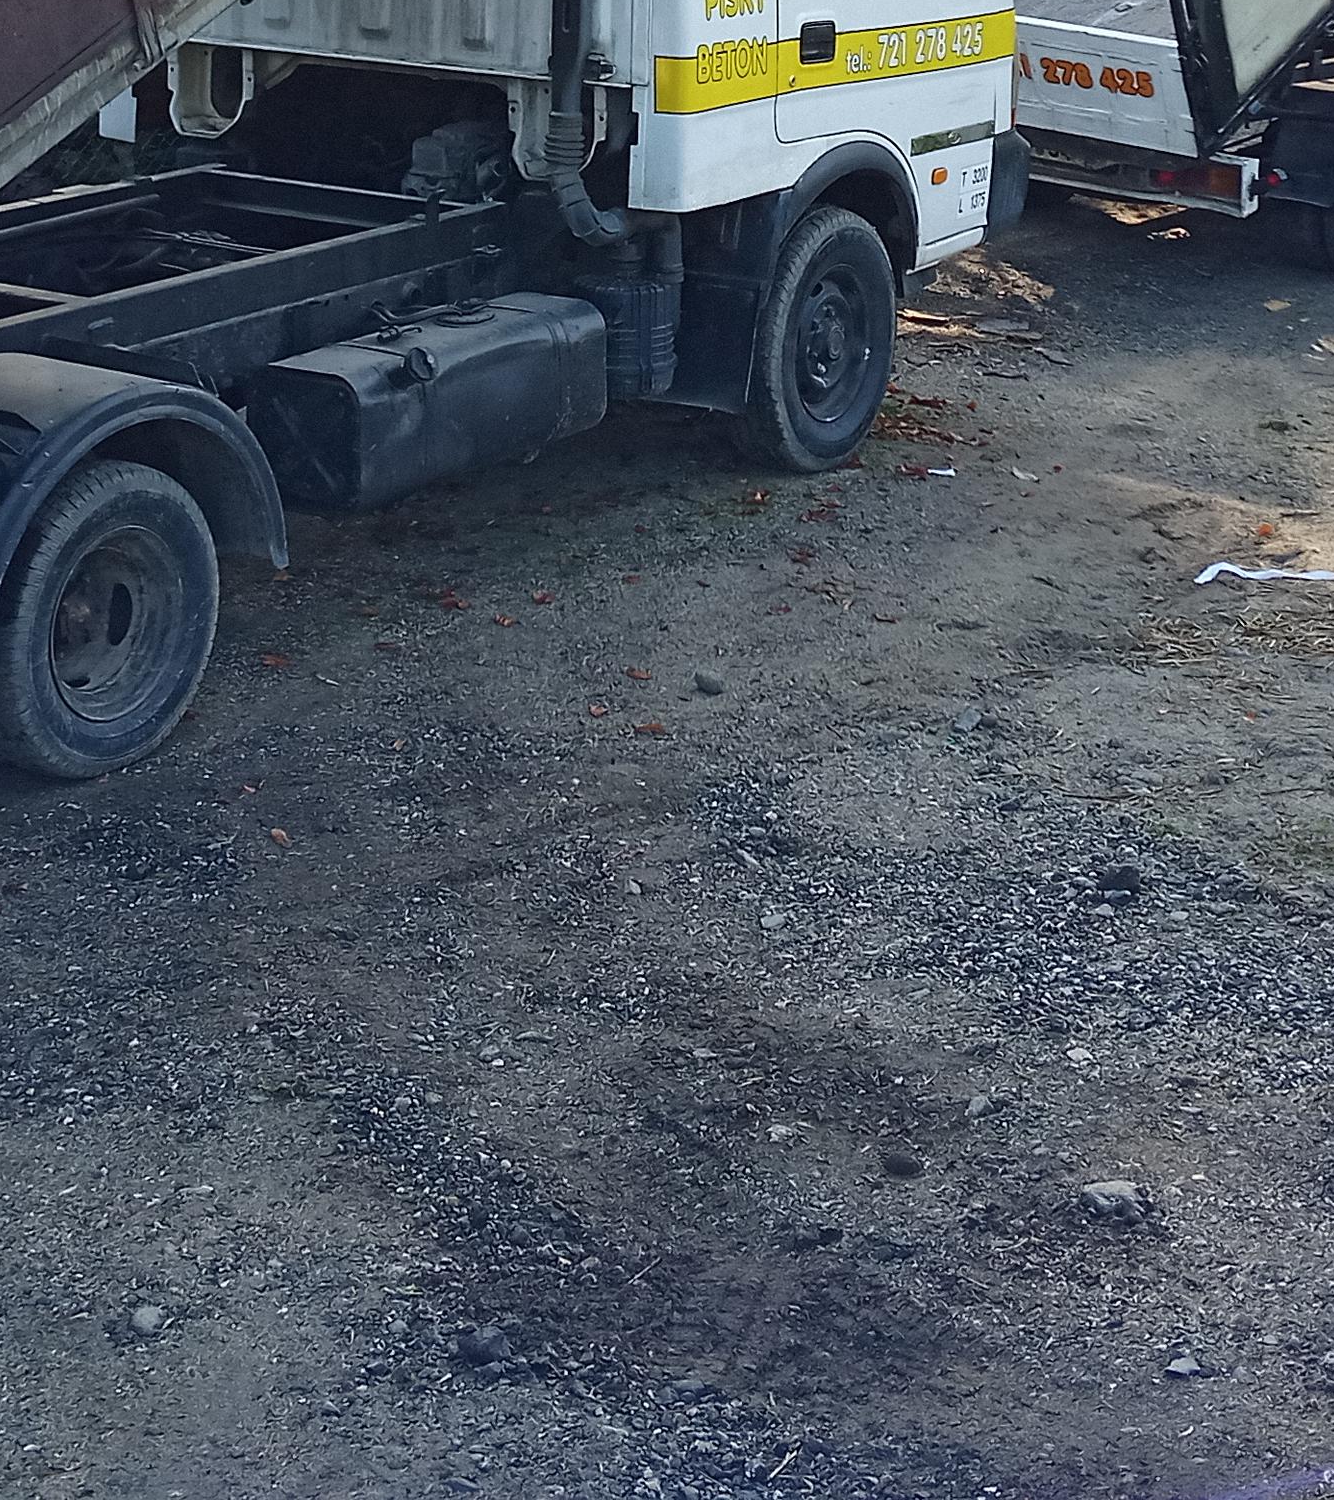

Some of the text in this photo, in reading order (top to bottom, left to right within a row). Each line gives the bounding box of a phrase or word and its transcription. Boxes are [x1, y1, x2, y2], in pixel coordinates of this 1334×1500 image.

[696, 36, 768, 84] BETON
[846, 21, 984, 75] tel.: 721 278 425
[1040, 57, 1094, 89] 278
[1100, 66, 1154, 98] 425
[962, 171, 967, 187] T
